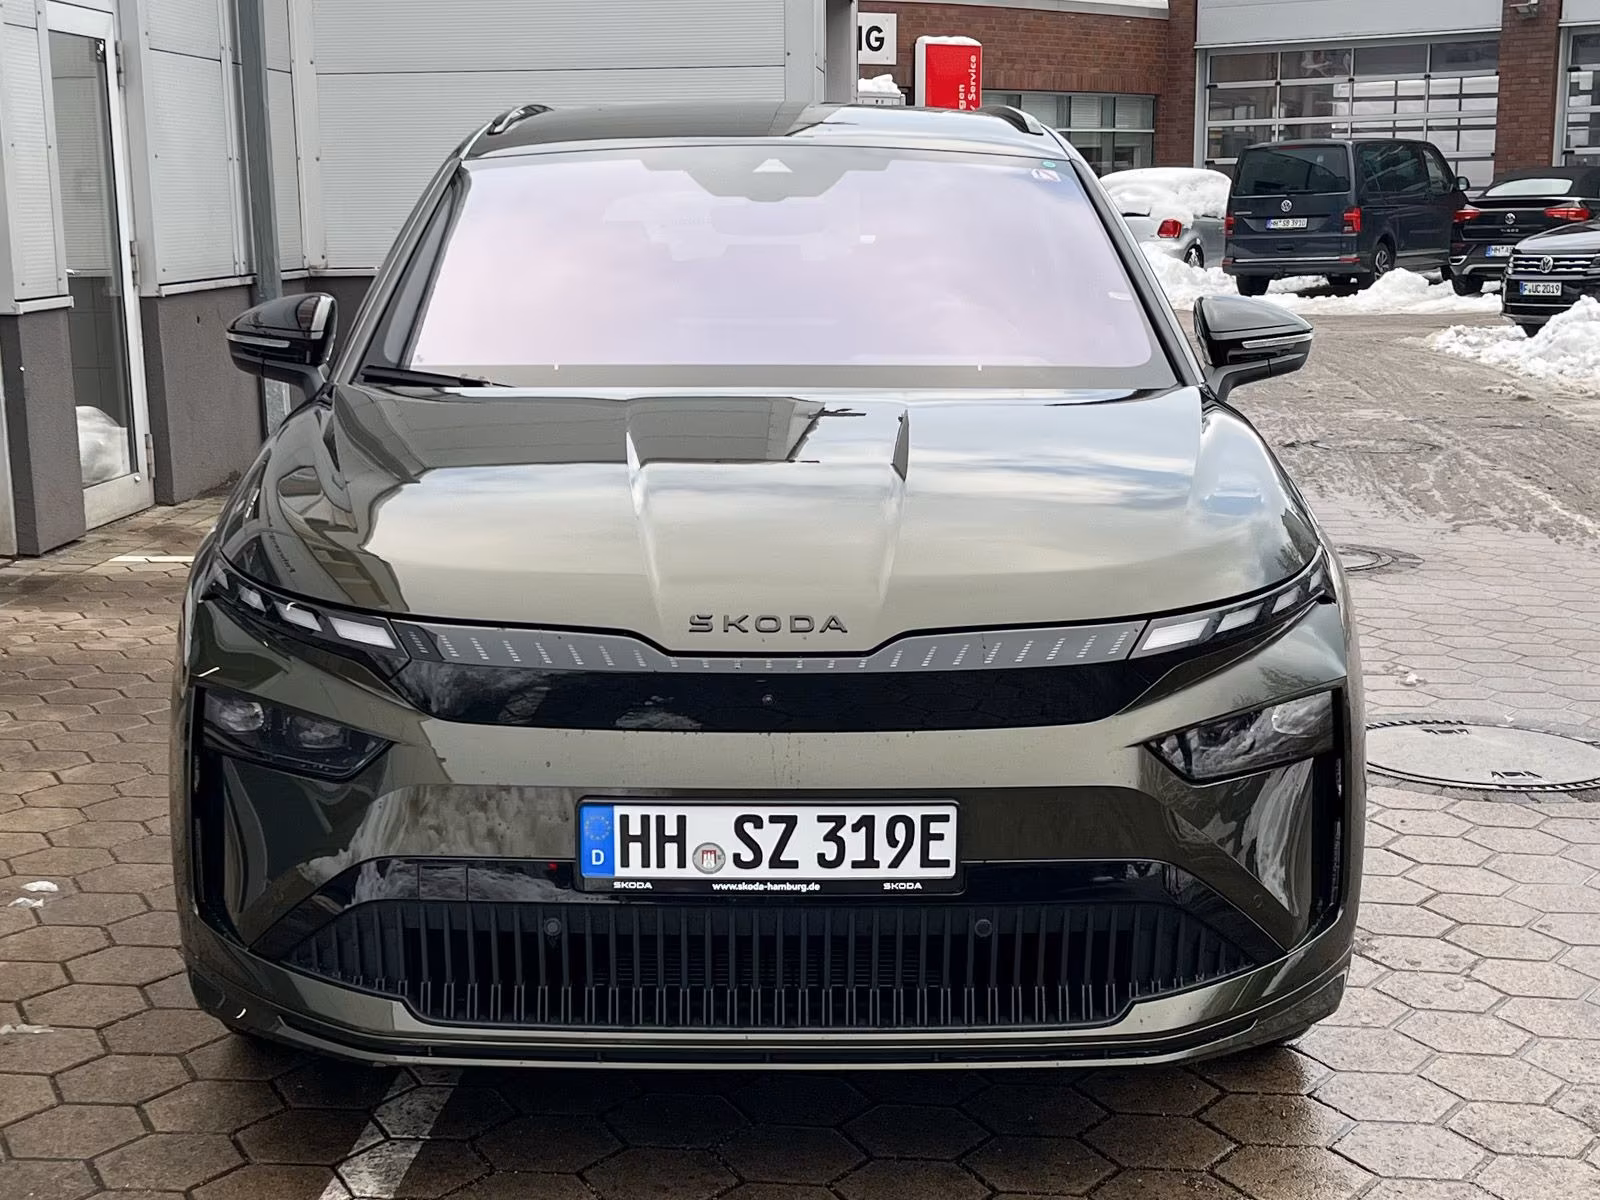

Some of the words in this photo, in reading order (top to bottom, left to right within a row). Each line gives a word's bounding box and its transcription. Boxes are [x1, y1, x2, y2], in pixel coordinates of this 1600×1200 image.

[968, 55, 977, 101] Service
[1542, 284, 1560, 294] 2019
[619, 813, 687, 869] HH
[732, 813, 799, 870] SZ
[816, 813, 951, 870] 319E
[592, 849, 604, 866] D
[712, 882, 821, 893] www.skoda-hamburg.de
